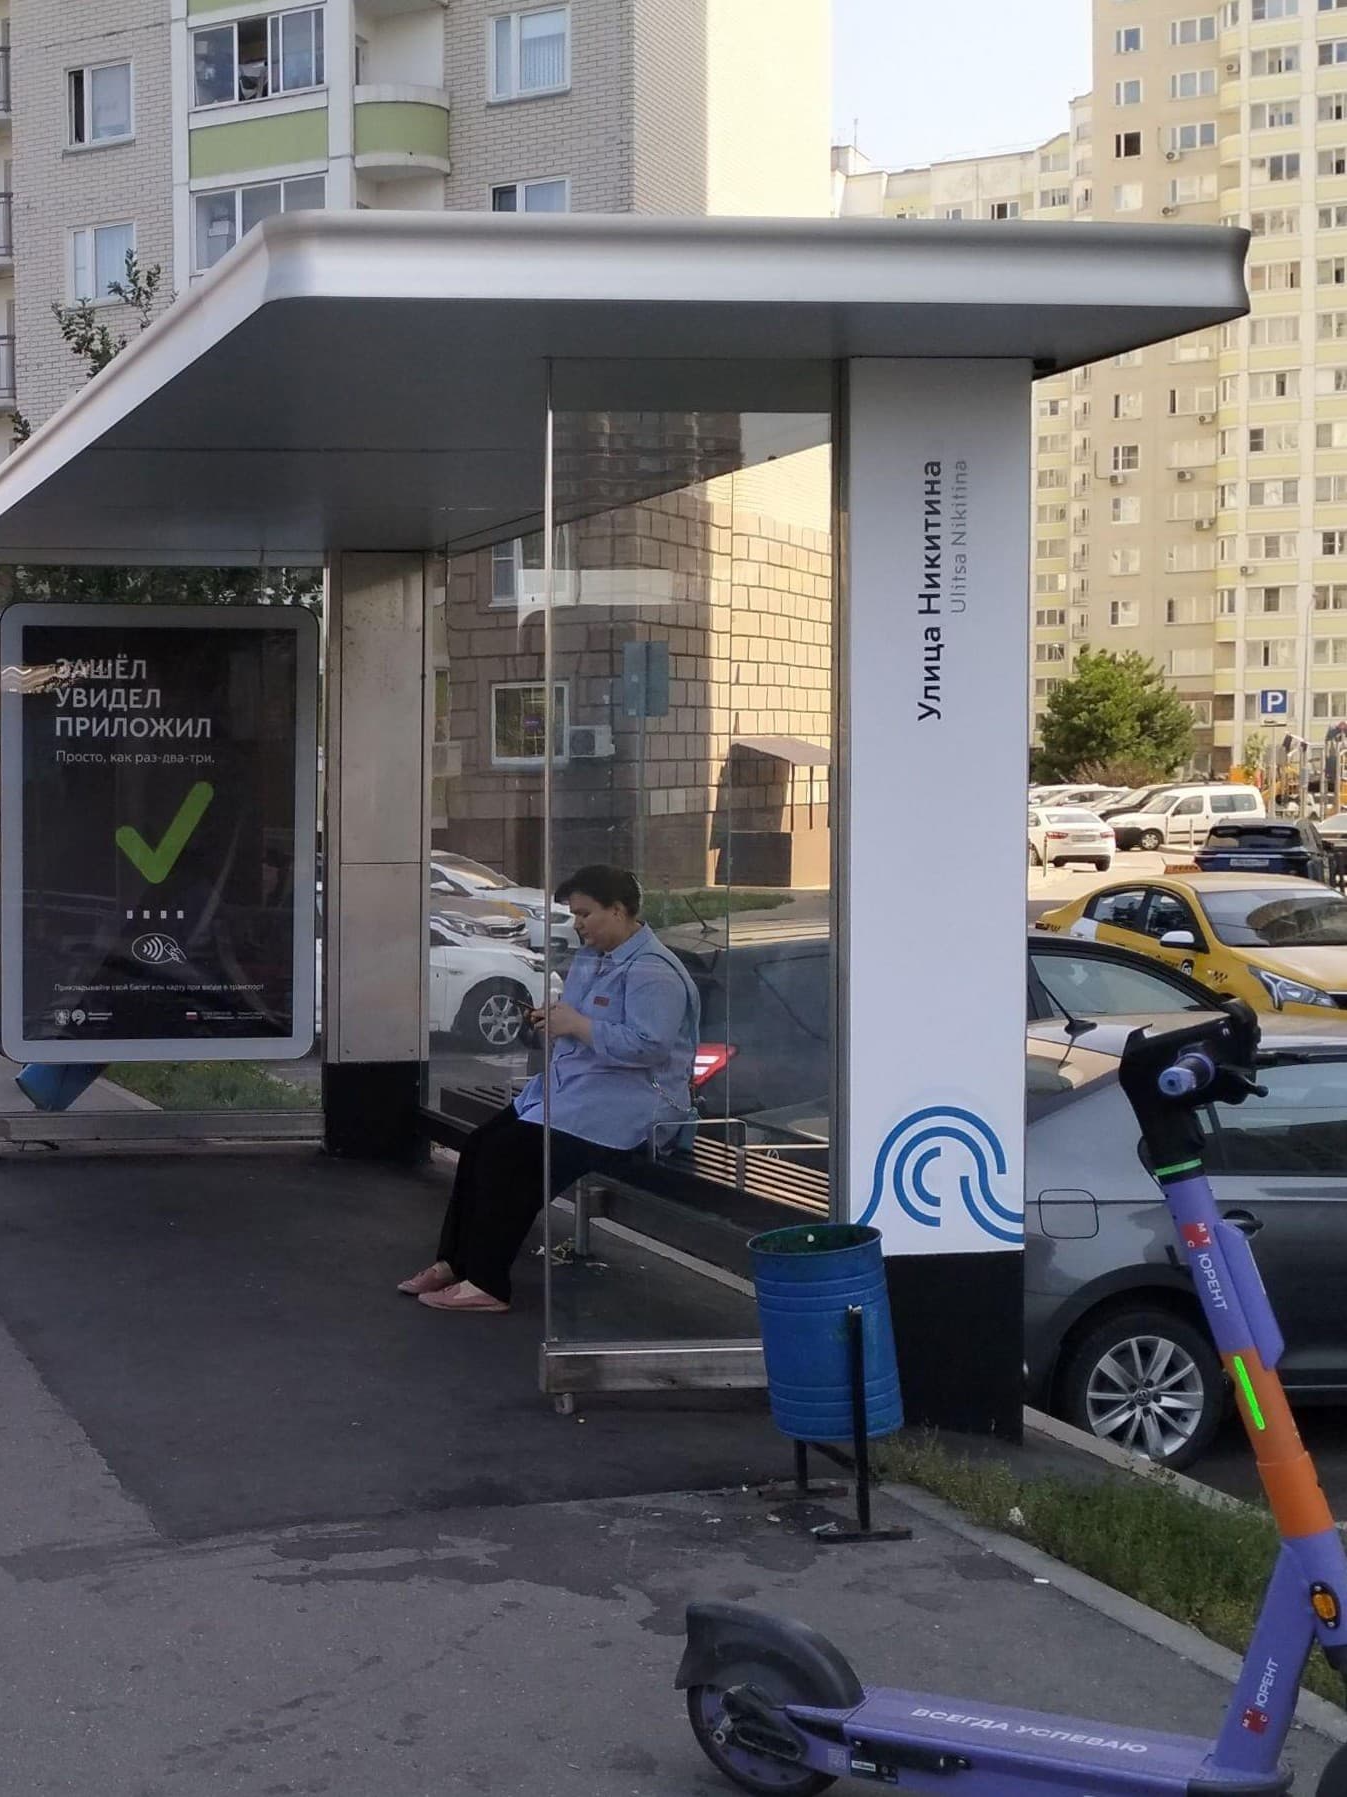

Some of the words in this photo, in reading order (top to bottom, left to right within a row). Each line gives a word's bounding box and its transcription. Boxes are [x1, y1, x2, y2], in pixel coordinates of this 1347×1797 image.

[950, 460, 967, 546] Nikitina
[917, 460, 941, 615] Никитина
[950, 554, 967, 613] Ulitsa
[55, 653, 147, 679] ЗАШЁЛ
[917, 626, 944, 721] Улица
[55, 688, 161, 712] УВИДЕЛ
[1266, 691, 1284, 712] P
[55, 716, 212, 738] ПРИЛОЖИЛ
[55, 750, 107, 765] Просто,
[110, 752, 132, 763] как
[135, 752, 215, 767] раз-два-три.
[1197, 1252, 1228, 1310] ЮРЕНТ
[1254, 1657, 1279, 1708] ЮРЕНТ
[911, 1708, 1008, 1731] ВСЕГДА
[1015, 1724, 1148, 1753] УСПЕВАЮ
